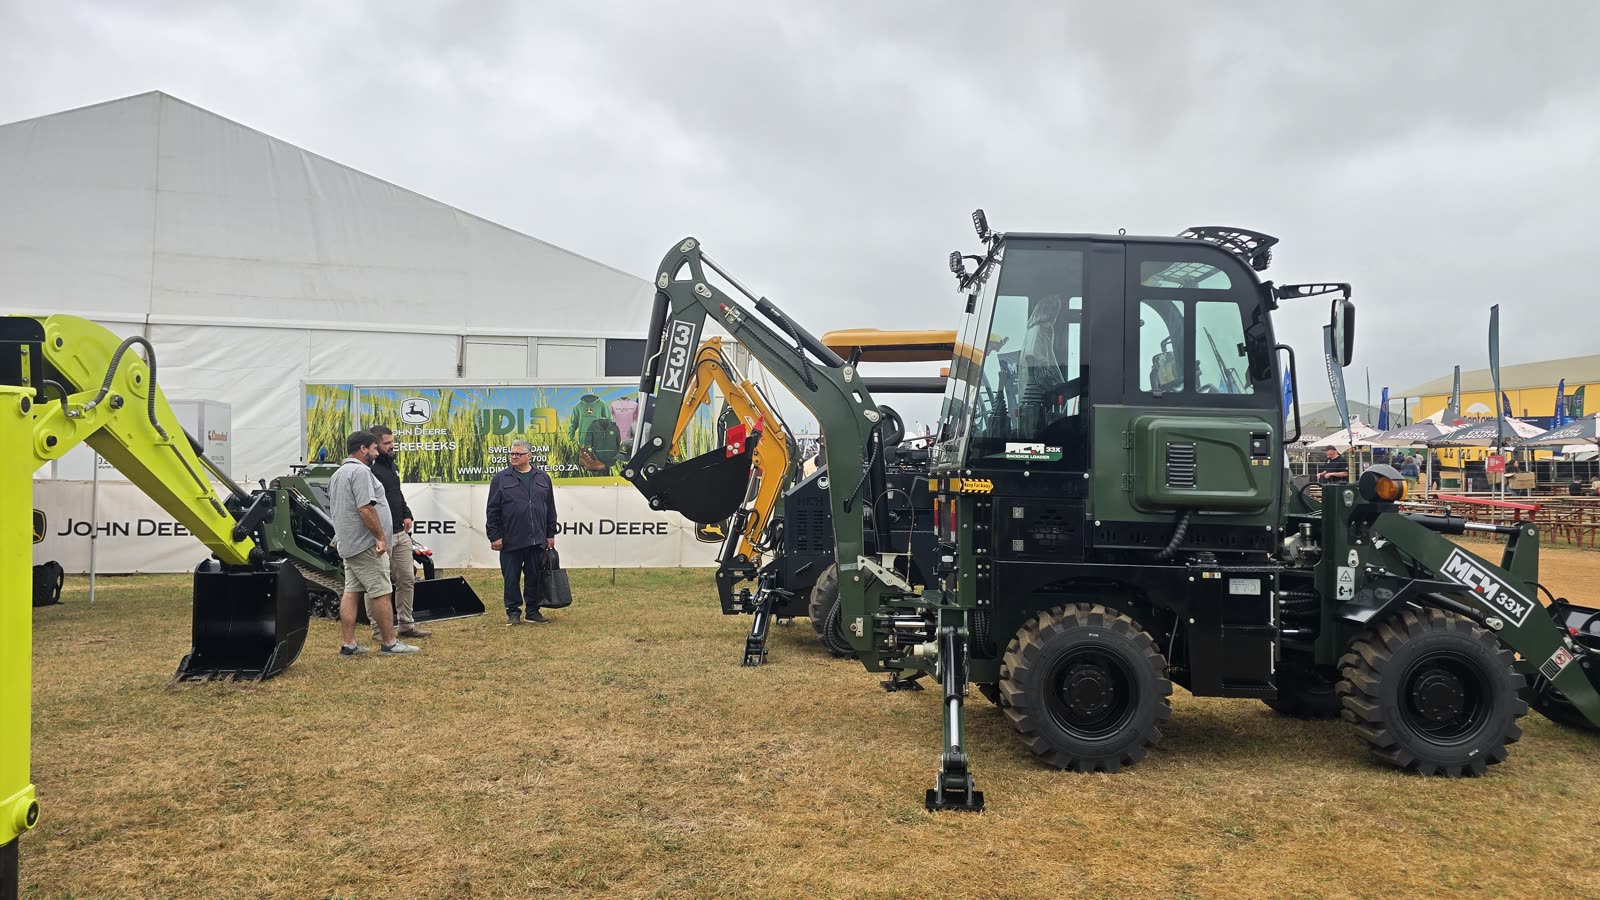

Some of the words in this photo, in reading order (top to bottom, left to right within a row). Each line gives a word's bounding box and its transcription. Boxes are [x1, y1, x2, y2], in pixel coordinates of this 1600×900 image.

[665, 325, 691, 389] 33X
[479, 408, 525, 435] JDI
[414, 427, 448, 436] DEERE
[392, 441, 456, 452] EREREEKS
[488, 445, 550, 454] SWELDAM
[1005, 442, 1046, 454] MCM
[491, 456, 507, 464] 028
[58, 518, 130, 536] JOHN
[137, 519, 193, 536] DEE
[413, 520, 457, 534] ERE
[556, 521, 593, 535] OHN
[599, 519, 668, 535] DEERE
[1446, 554, 1501, 601] MCM
[1495, 592, 1526, 618] 33X
